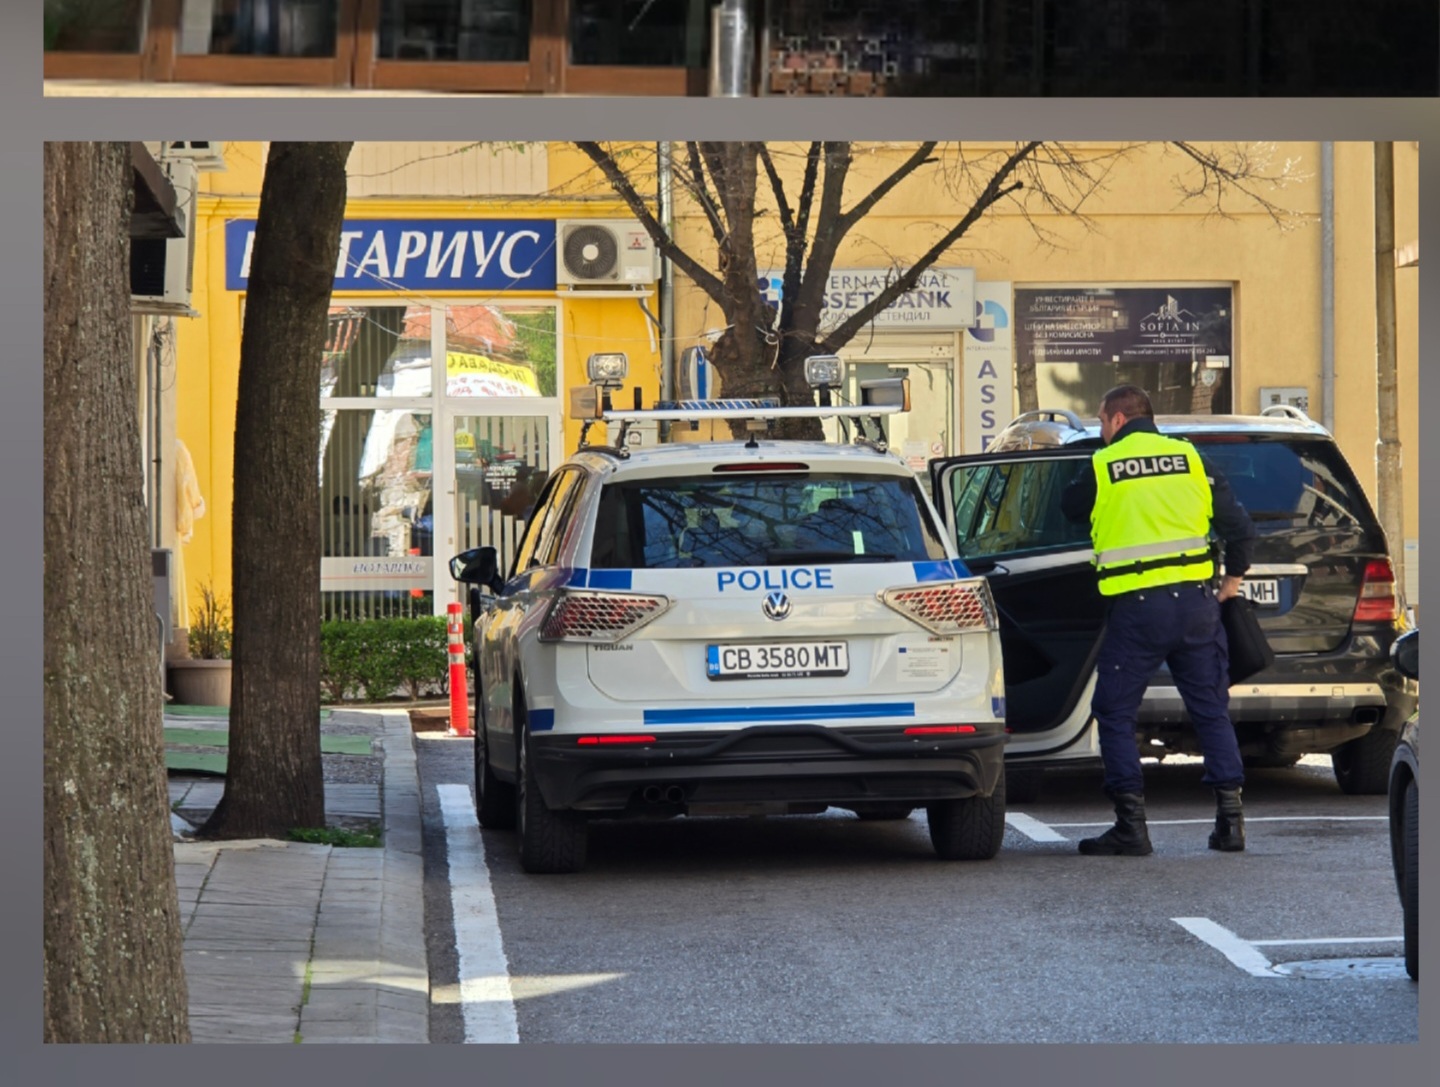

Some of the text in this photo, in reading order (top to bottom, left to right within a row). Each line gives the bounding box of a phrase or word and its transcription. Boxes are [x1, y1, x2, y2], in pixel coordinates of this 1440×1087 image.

[240, 229, 539, 279] ТАРИУС
[821, 291, 952, 309] SSET ANK
[1139, 322, 1200, 332] SOFIA IN
[1111, 455, 1187, 479] POLICE
[717, 567, 834, 592] POLICE
[593, 643, 634, 652] TIGUAN
[756, 646, 810, 669] 3580
